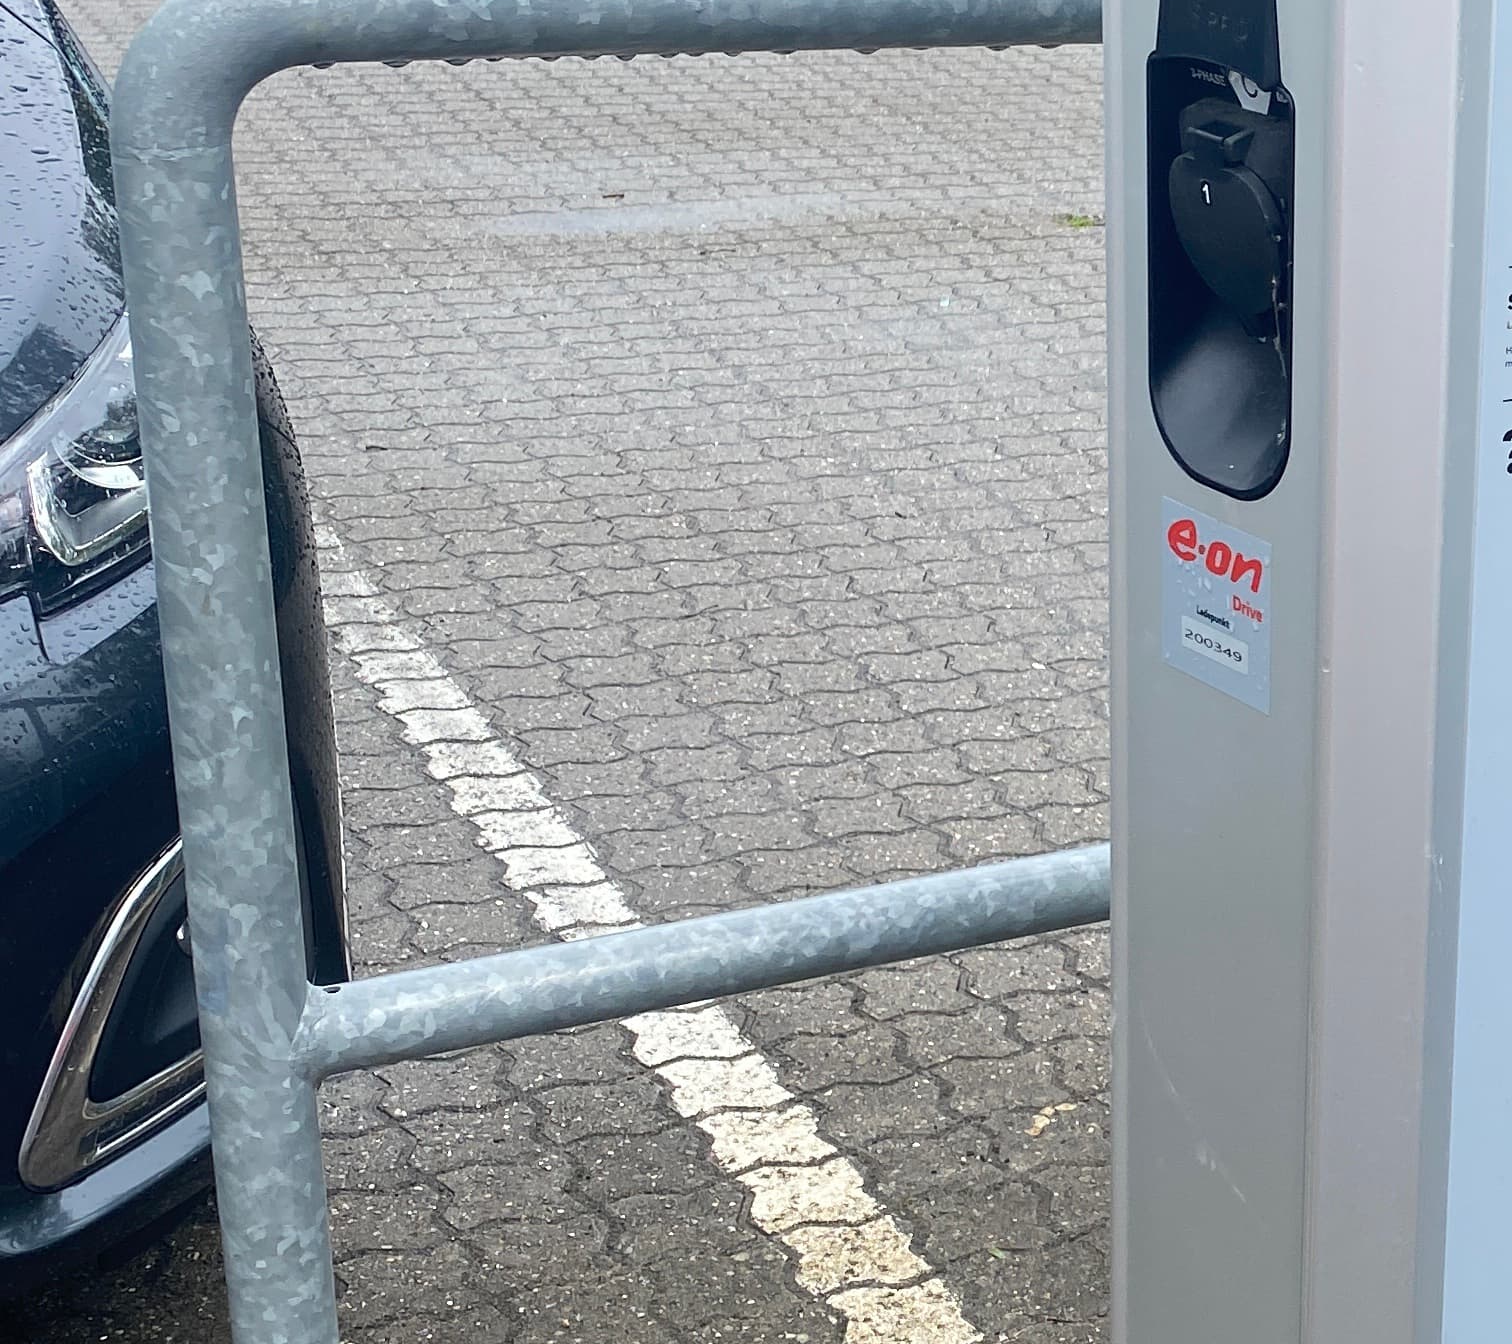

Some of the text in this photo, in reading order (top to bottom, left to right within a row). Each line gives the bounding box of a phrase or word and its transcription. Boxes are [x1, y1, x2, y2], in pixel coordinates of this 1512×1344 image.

[1201, 183, 1211, 205] 1
[1232, 594, 1263, 623] Drive
[1184, 628, 1243, 662] 200349
